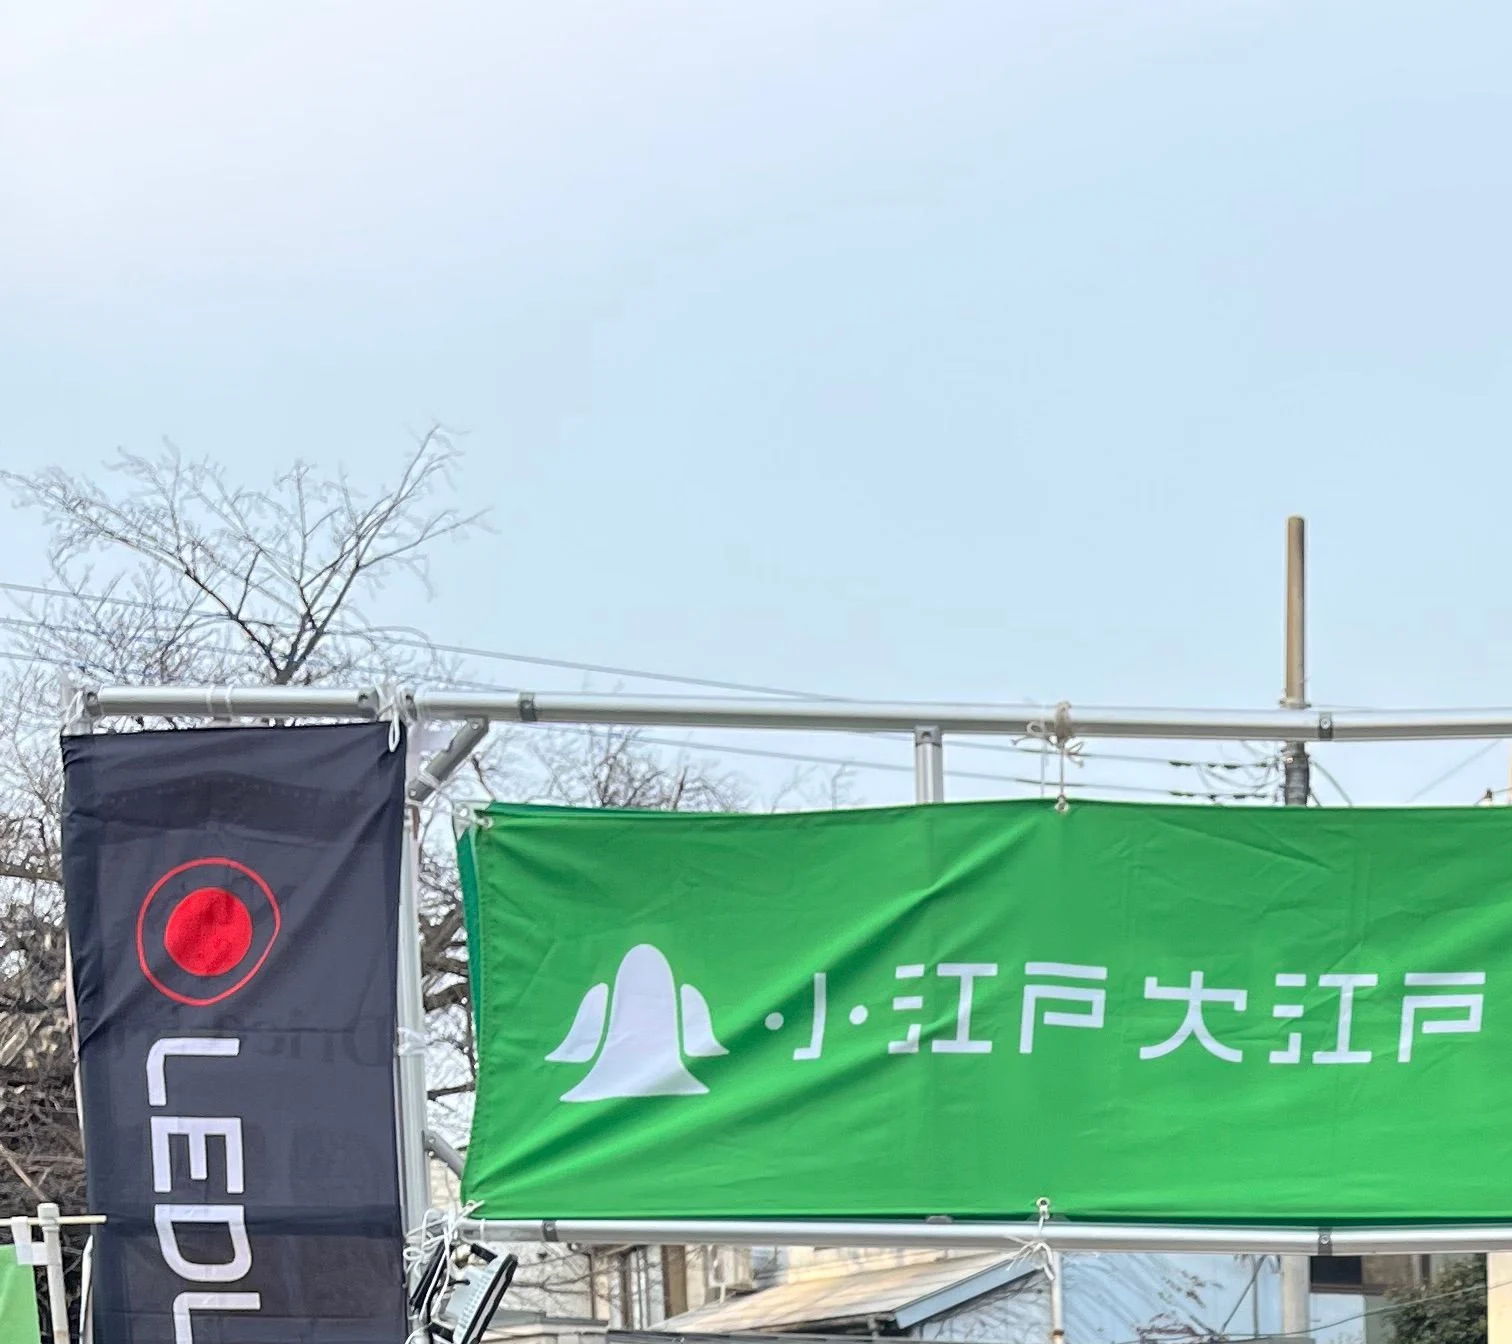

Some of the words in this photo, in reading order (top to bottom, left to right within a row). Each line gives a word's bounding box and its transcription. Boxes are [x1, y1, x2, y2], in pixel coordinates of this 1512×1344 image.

[765, 962, 1486, 1064] 小江戸大江戸
